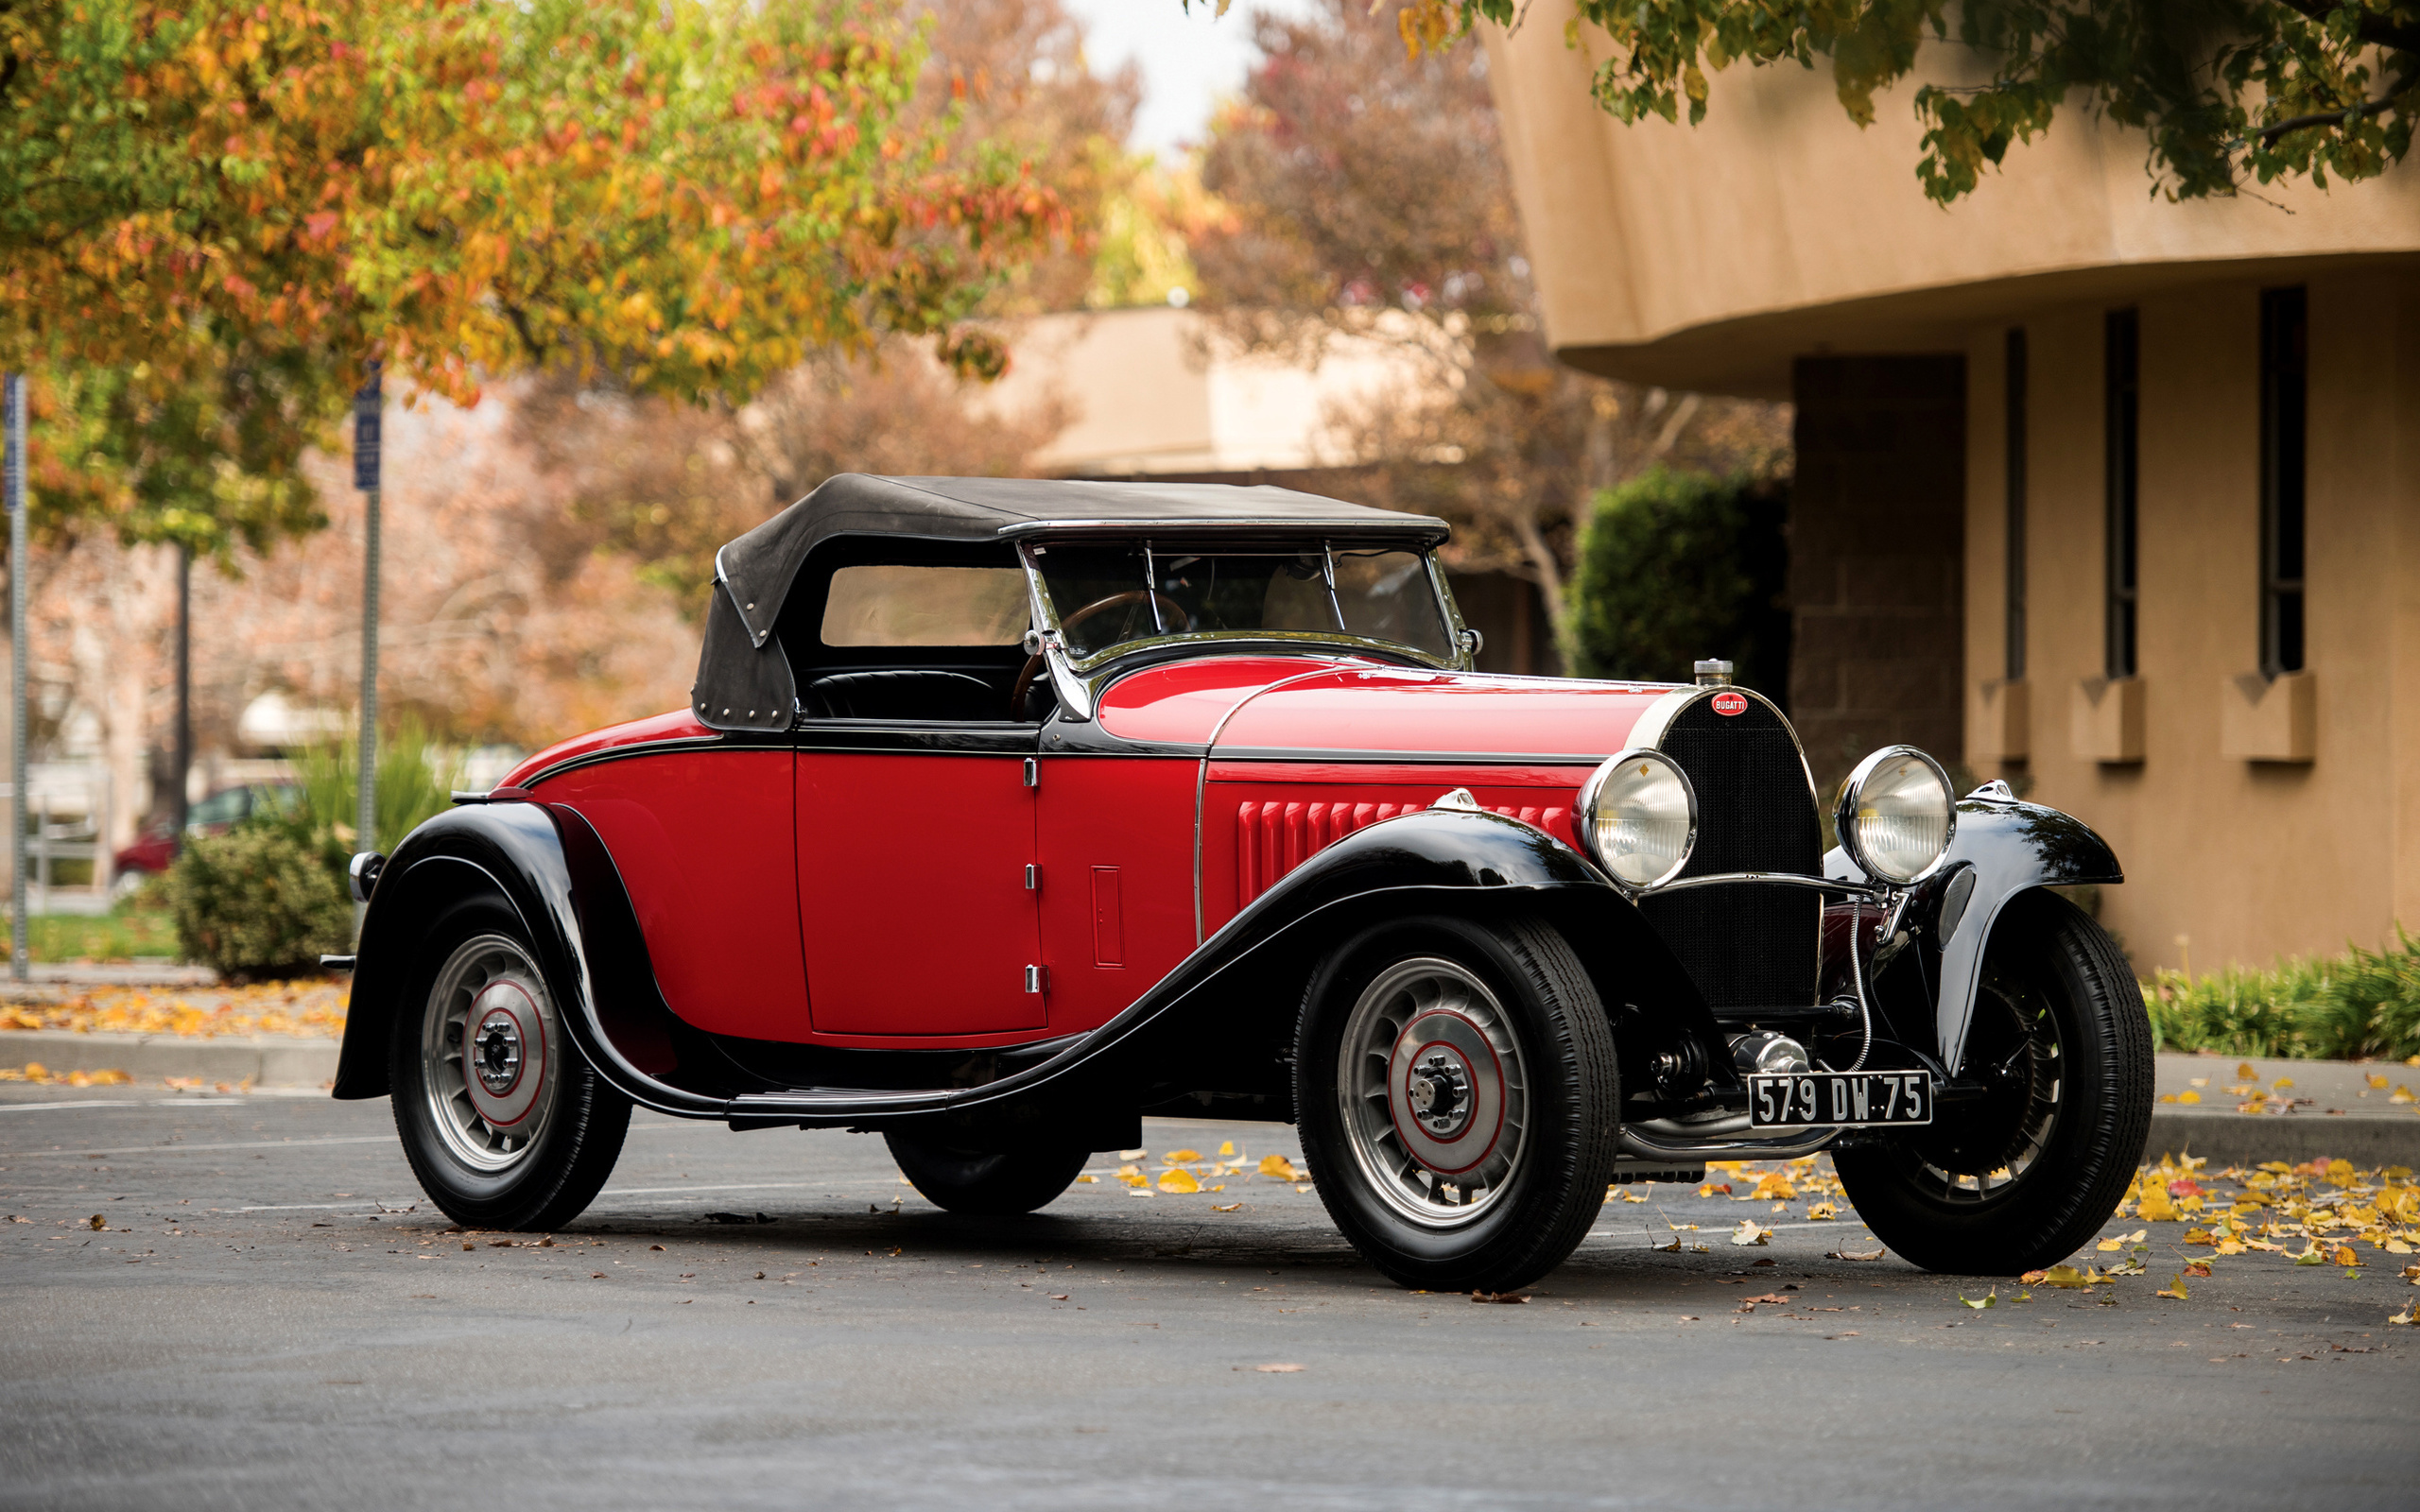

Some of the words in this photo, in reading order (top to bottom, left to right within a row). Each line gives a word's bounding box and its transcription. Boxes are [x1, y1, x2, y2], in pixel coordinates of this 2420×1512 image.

[1716, 700, 1745, 710] BUGATTI
[1757, 1078, 1817, 1122] 579
[1831, 1077, 1869, 1121] DW
[1883, 1076, 1922, 1120] 75
